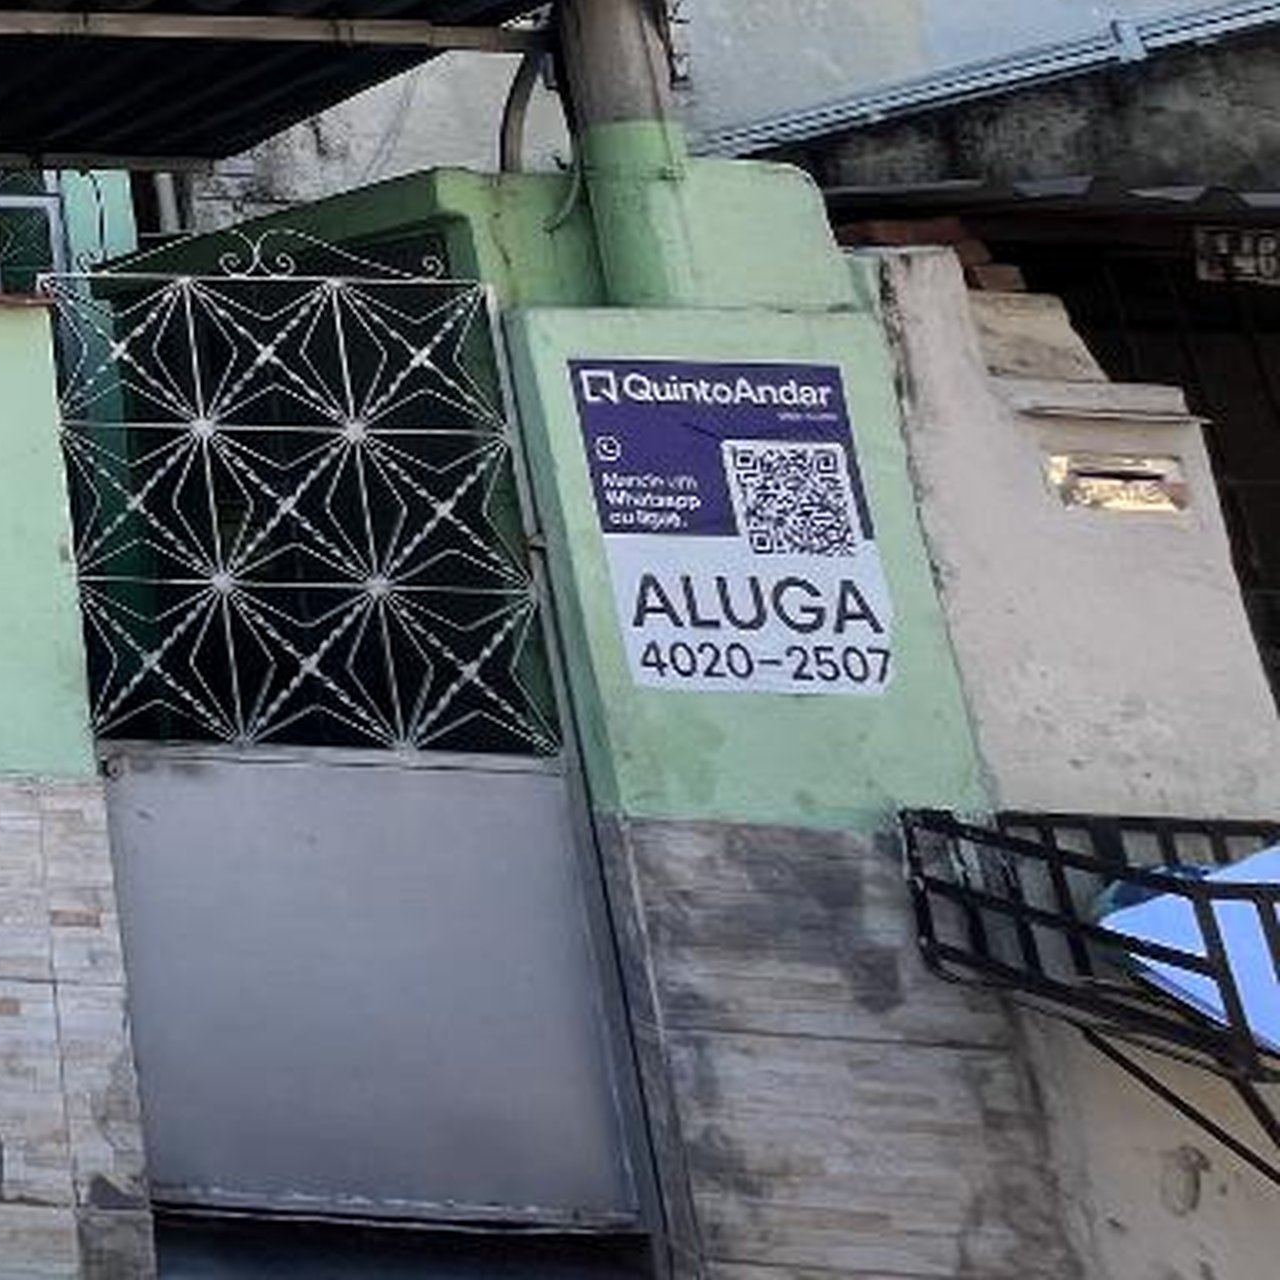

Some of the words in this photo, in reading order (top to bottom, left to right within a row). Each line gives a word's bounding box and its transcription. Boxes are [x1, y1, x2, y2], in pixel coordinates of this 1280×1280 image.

[623, 372, 833, 407] QuintoAndar
[632, 574, 884, 634] ALUGA
[640, 641, 891, 684] 4020-2507
